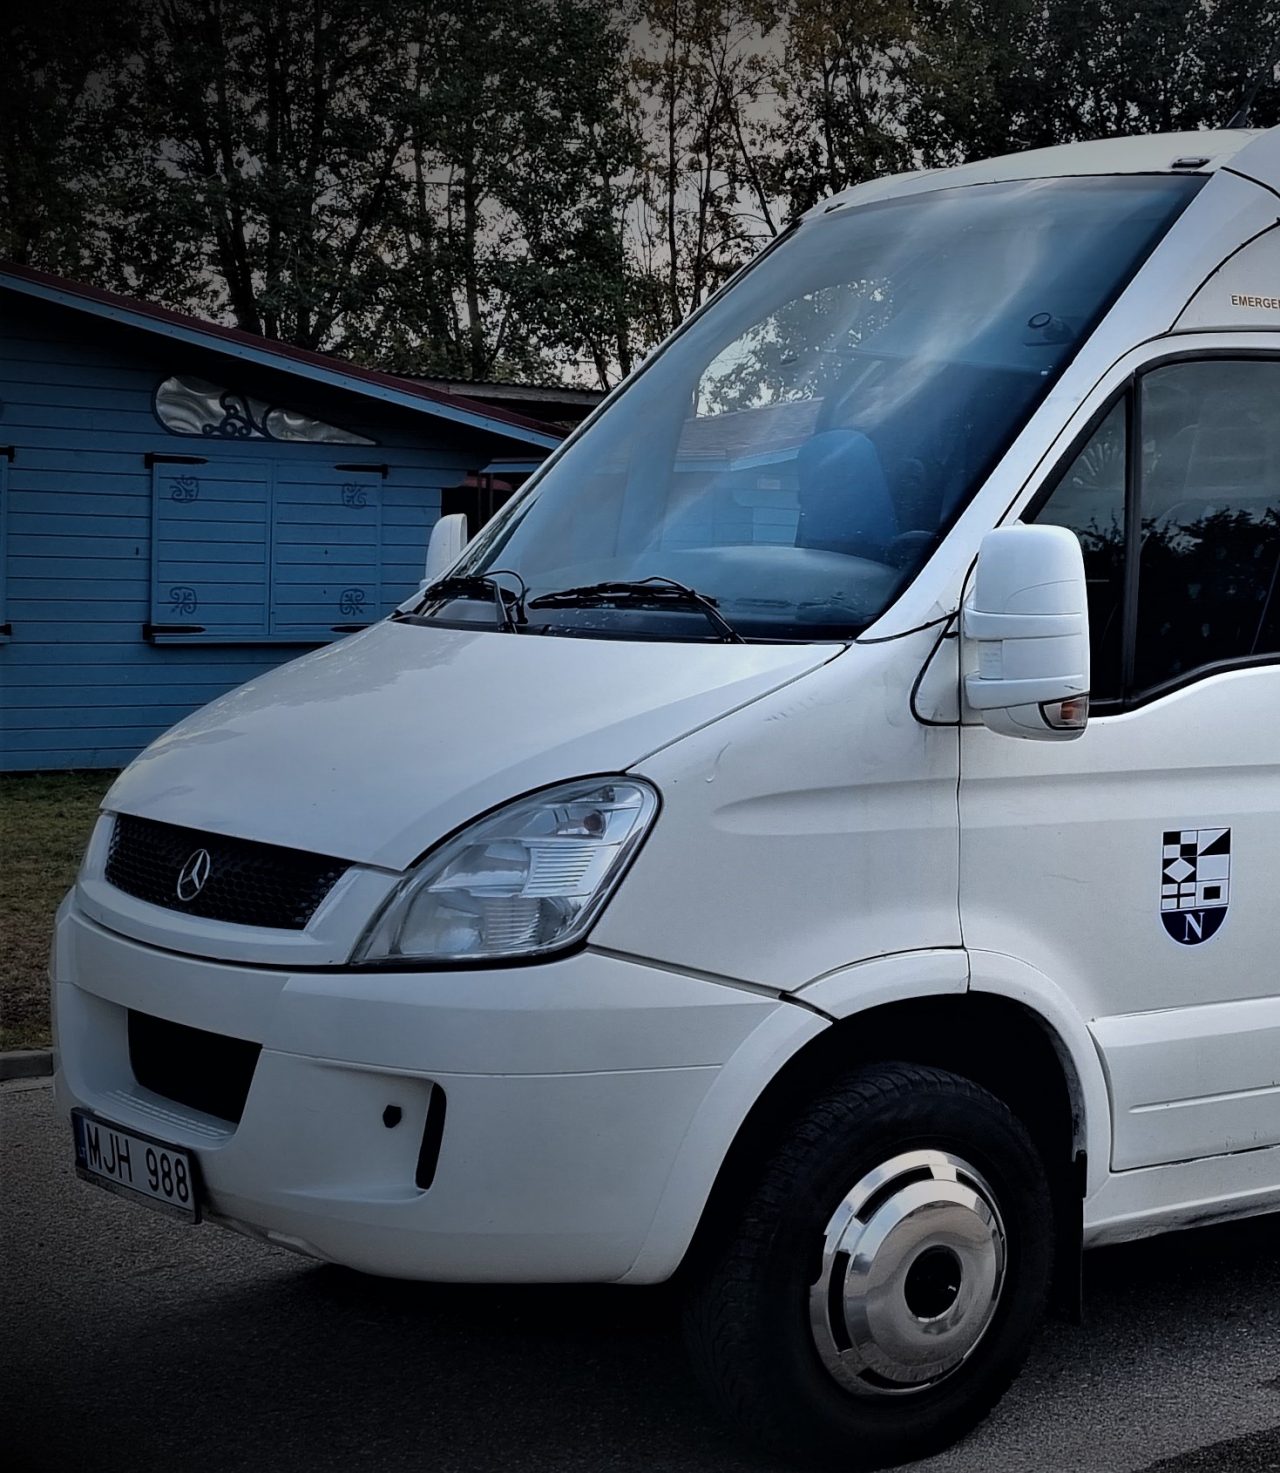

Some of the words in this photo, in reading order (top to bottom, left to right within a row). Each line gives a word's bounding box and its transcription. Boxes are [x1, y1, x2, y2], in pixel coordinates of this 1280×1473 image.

[1182, 911, 1205, 941] N
[86, 1123, 133, 1182] MJH
[145, 1147, 189, 1203] 988
